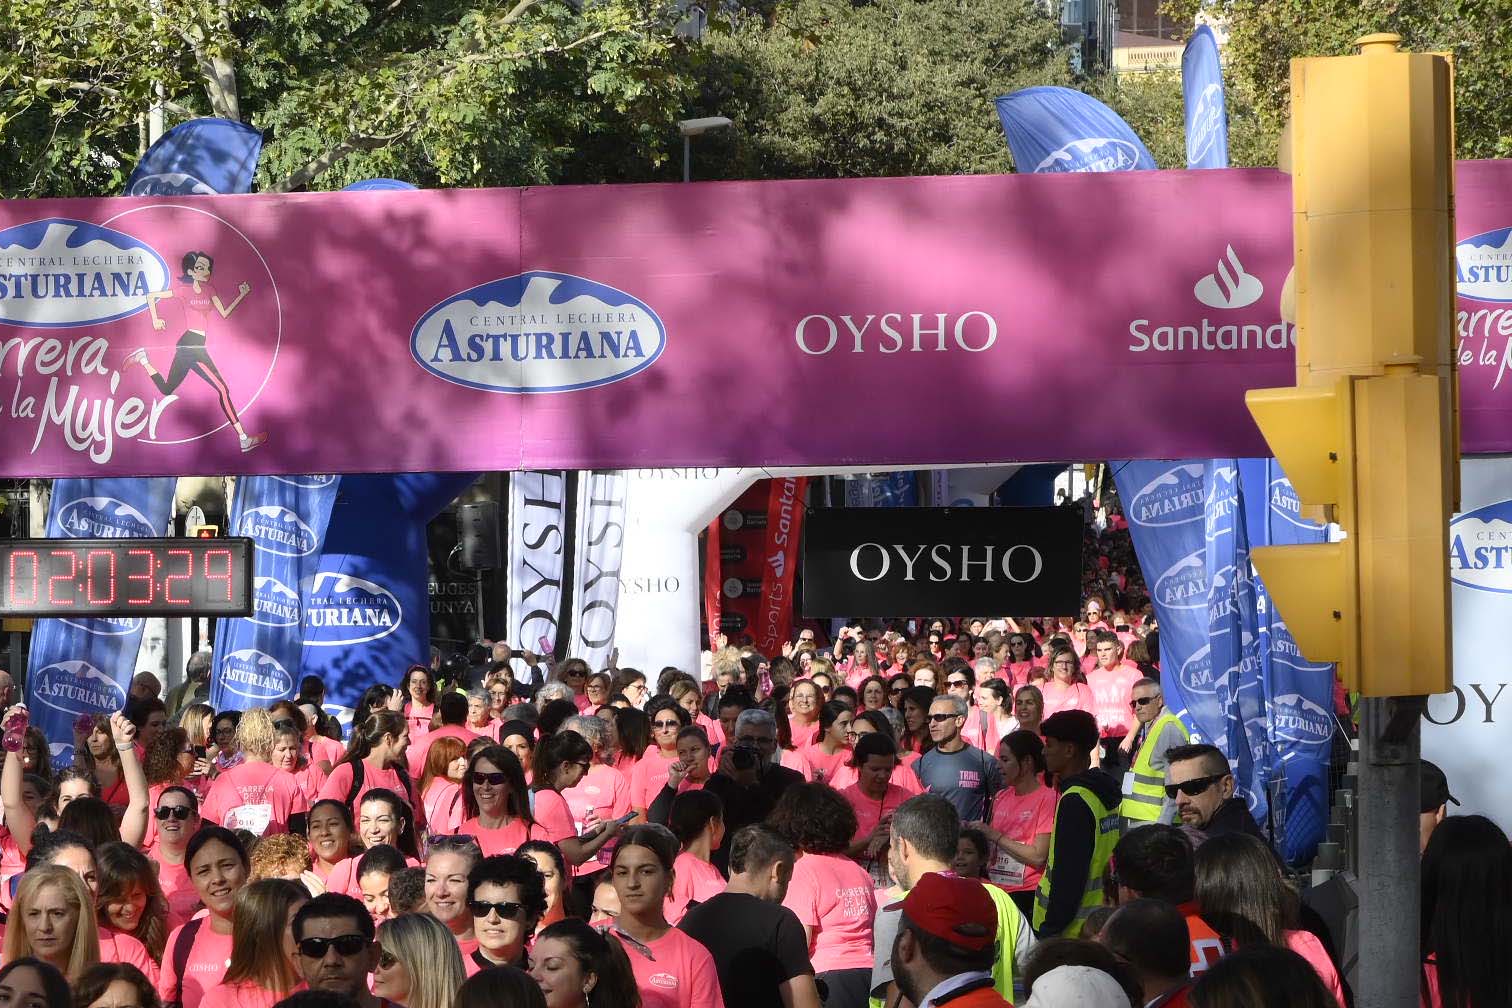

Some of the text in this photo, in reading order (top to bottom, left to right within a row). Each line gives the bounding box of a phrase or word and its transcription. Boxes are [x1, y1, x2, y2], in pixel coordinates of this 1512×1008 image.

[72, 254, 145, 266] LECHERA
[430, 317, 646, 363] ASTURIANA
[469, 311, 639, 327] CENTRAL LECHERA
[795, 310, 999, 355] OYSHO
[1479, 338, 1497, 366] la
[10, 376, 36, 419] la
[30, 369, 180, 465] Mujer
[8, 550, 234, 606] 02:03:29
[849, 542, 1044, 584] OYSHO
[37, 673, 118, 711] ASTURIANA
